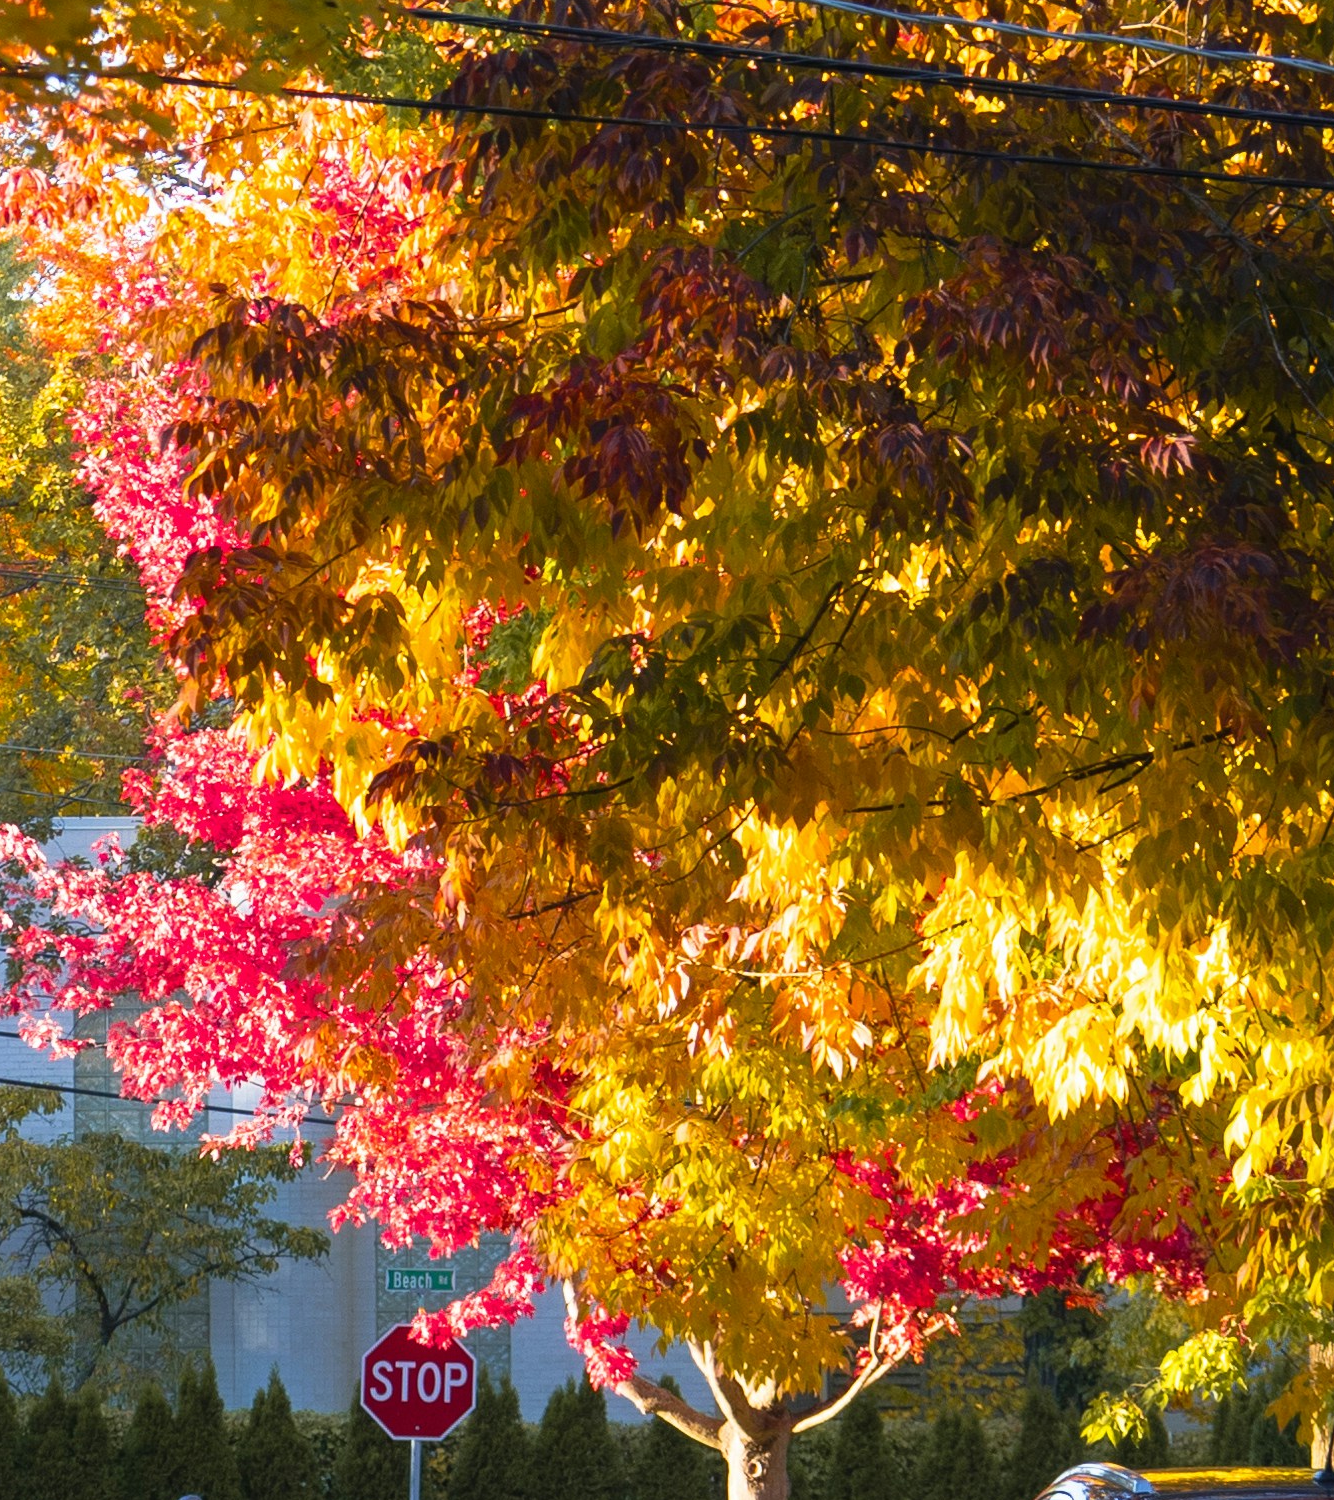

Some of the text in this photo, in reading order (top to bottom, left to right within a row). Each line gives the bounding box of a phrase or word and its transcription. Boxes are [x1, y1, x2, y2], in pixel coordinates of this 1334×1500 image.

[393, 1271, 449, 1288] Beach Rd
[370, 1360, 468, 1403] STOP
